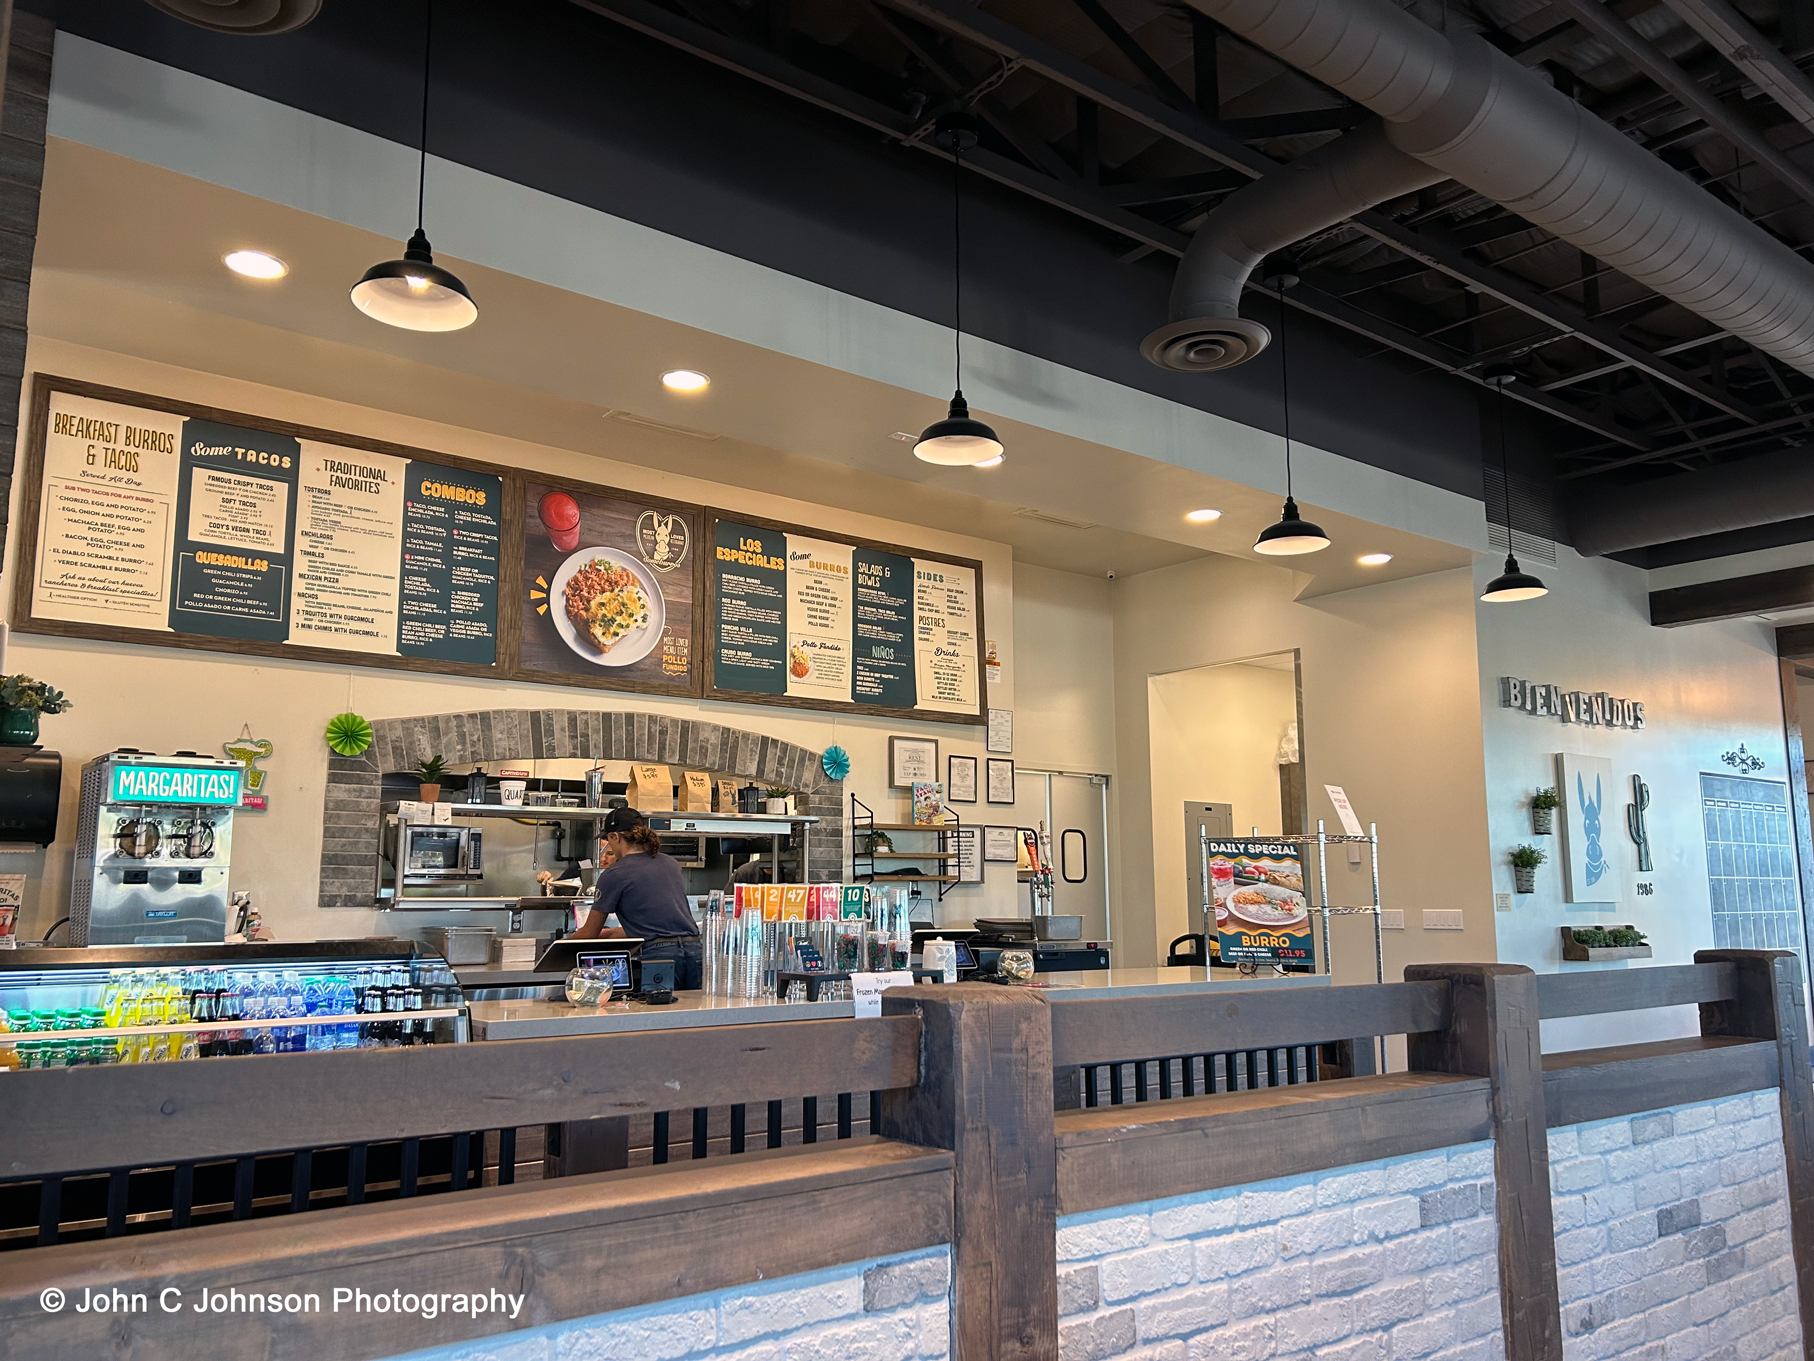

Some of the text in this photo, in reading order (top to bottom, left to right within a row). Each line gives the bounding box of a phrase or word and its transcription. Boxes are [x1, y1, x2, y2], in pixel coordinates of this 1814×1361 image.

[54, 412, 174, 455] BREAKFAST BURROS
[86, 445, 139, 473] & TACOS
[190, 441, 292, 469] Some TACOS
[323, 459, 388, 483] TRADITIONAL
[80, 470, 143, 487] Served All Day
[208, 475, 274, 492] FAMOUS CRISPY TACOS
[330, 474, 380, 495] FAVORITES
[92, 489, 109, 497] TACOS
[304, 485, 331, 496] TOSTADAS
[421, 480, 487, 506] COMBOS
[59, 496, 90, 505] CHORIZO,
[221, 497, 257, 509] SOFT TACOS
[62, 506, 77, 514] EGG,
[67, 518, 98, 527] MACHACA
[118, 524, 131, 532] EGG
[209, 522, 267, 537] CODY'S VEGAN TACO
[65, 534, 89, 542] BACON,
[107, 539, 130, 547] CHEESE
[301, 530, 334, 541] ENCHILADAS
[739, 537, 762, 553] LOS
[62, 550, 85, 558] DIABLO
[87, 552, 120, 561] SCRAMBLE
[300, 550, 325, 559] TAMALES
[716, 546, 786, 572] ESPECIALES
[57, 559, 113, 571] VERDE SCRAMBLE
[195, 551, 269, 573] QUESADILLAS
[789, 550, 849, 575] Some BURROS
[203, 568, 221, 576] GREEN
[857, 562, 883, 578] SALADS
[884, 567, 891, 579] &
[916, 570, 944, 584] SIDES
[120, 579, 143, 588] huevos
[211, 578, 244, 587] GUACAMOLE
[298, 573, 339, 584] MEXICAN PIZZA
[858, 573, 881, 589] BOWLS
[44, 579, 158, 597] rancheros breakfast specialties!
[215, 587, 240, 595] CHORIZO
[297, 592, 318, 600] NACHOS
[301, 609, 328, 618] TAQUITOS
[343, 614, 375, 624] GUACAMOLE
[918, 615, 946, 629] POSTRES
[314, 624, 333, 632] CHIMIS
[348, 628, 379, 638] GUACAMOLE
[663, 636, 688, 647] MOST LOVED
[663, 645, 688, 656] MENU ITEM
[872, 645, 894, 661] NIÑOS
[934, 647, 960, 658] Drinks
[662, 654, 688, 665] POLLO
[662, 663, 688, 672] FUNDIDO
[1502, 677, 1646, 729] BIENVENIDOS
[119, 770, 234, 799] MARGARITAS!
[1210, 842, 1298, 856] DAILY SPECIAL
[0, 887, 20, 902] RITAS
[769, 889, 778, 902] 2
[787, 889, 805, 902] 47
[823, 889, 837, 902] 44
[847, 889, 861, 902] 10
[1636, 882, 1653, 896] 1986
[1241, 935, 1290, 948] BURRO
[1278, 949, 1306, 959] $11.95
[875, 977, 883, 986] Try
[856, 988, 873, 997] Frozen
[867, 998, 879, 1006] while
